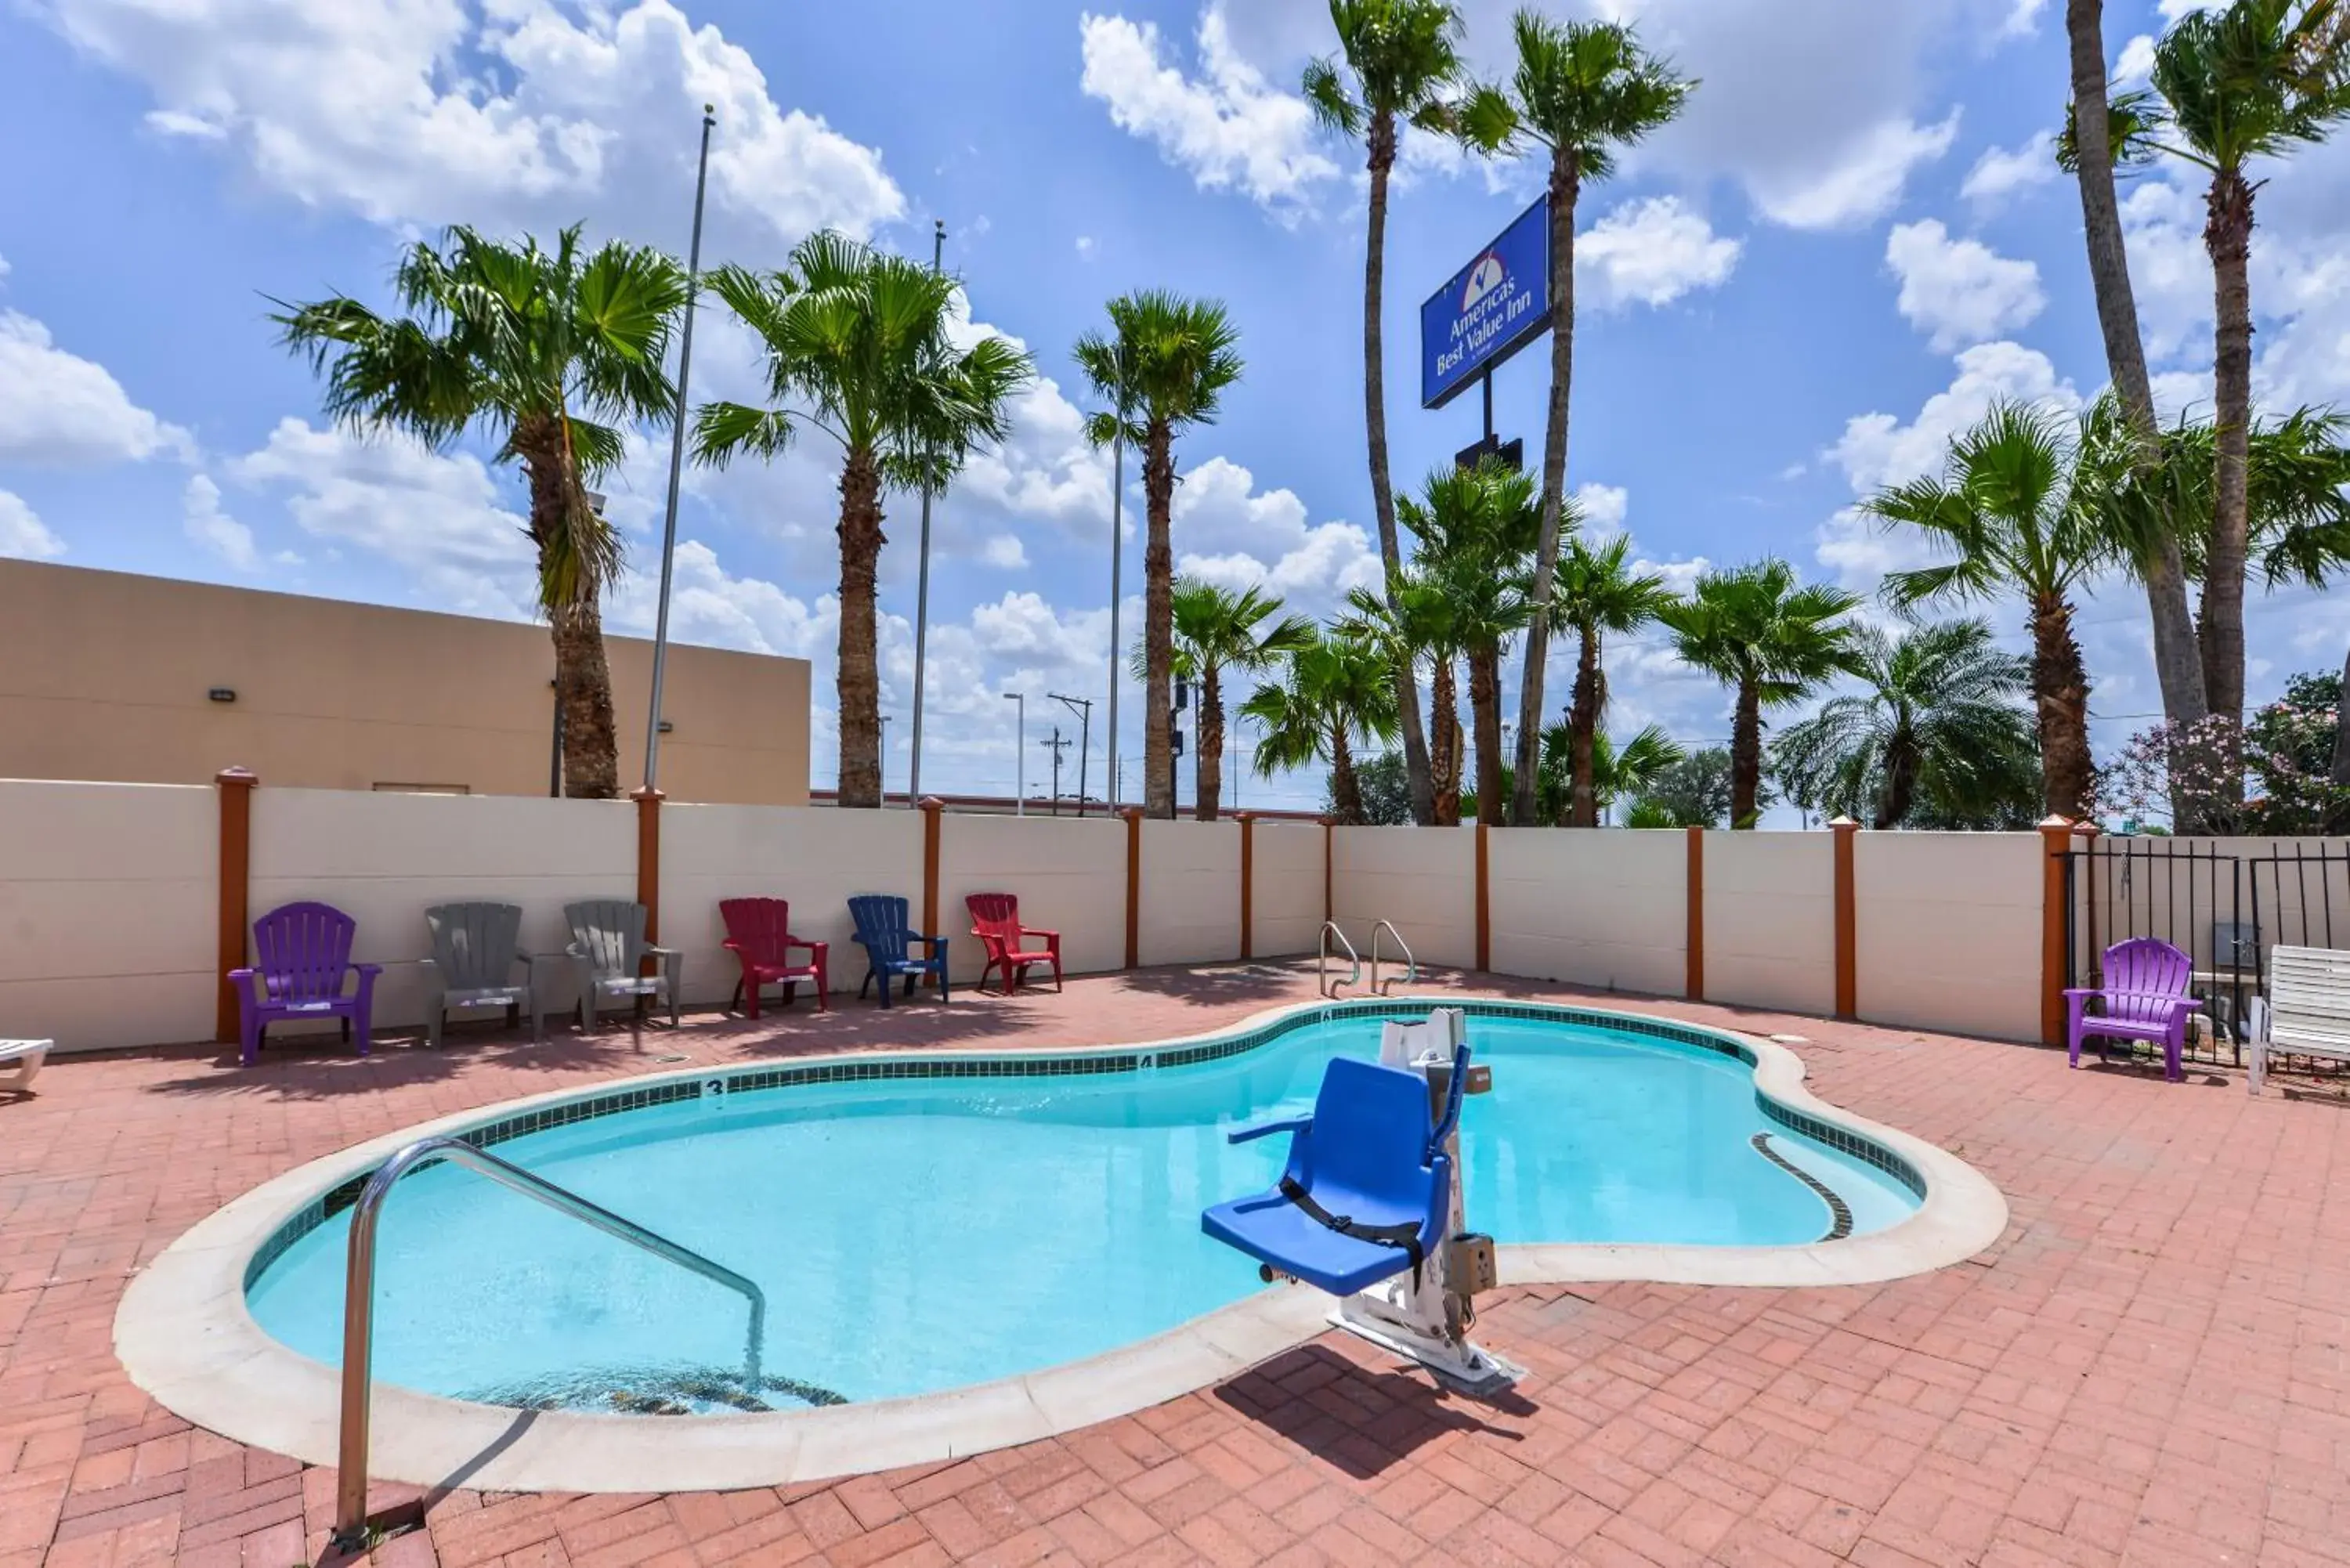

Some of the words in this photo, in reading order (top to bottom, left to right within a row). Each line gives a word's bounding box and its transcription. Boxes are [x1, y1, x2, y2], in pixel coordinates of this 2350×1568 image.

[1437, 340, 1463, 376] Best
[1466, 313, 1503, 351] Value
[1507, 290, 1531, 322] Inn
[1450, 276, 1515, 342] Americas
[707, 1079, 723, 1095] 3
